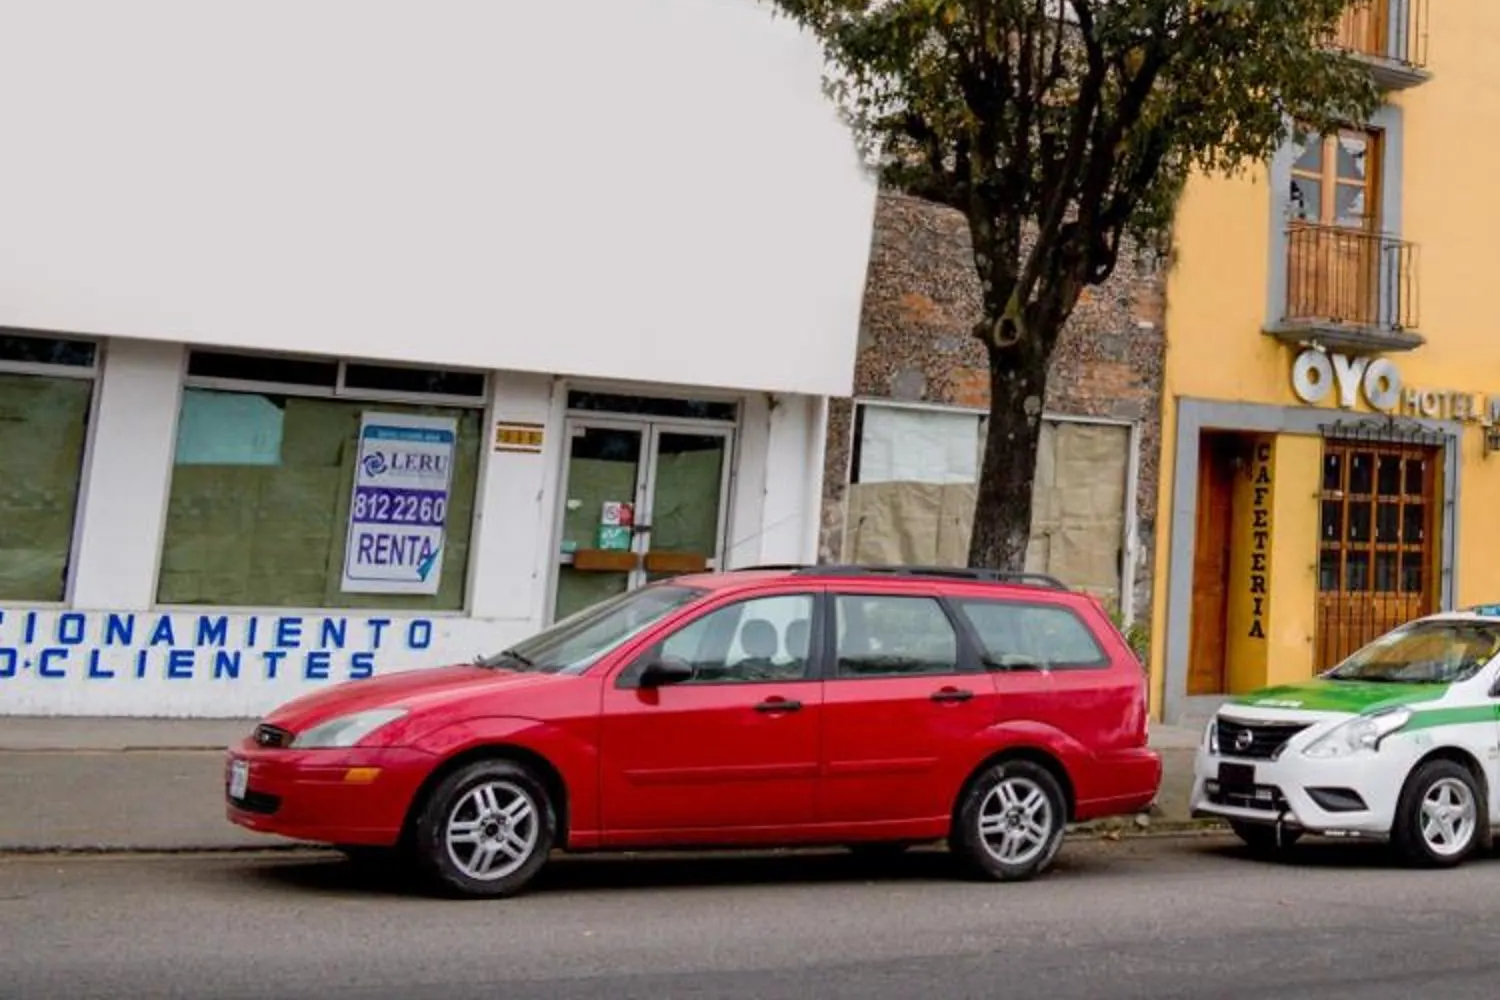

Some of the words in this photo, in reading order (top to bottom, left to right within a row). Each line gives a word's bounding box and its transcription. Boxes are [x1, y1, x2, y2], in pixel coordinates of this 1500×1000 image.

[1292, 349, 1402, 411] OYO
[1402, 387, 1478, 421] HOTEL
[391, 451, 449, 473] LERU
[356, 532, 435, 568] RENTA
[1248, 443, 1271, 639] CAFETERIA
[0, 611, 433, 649] IONAMIENTO
